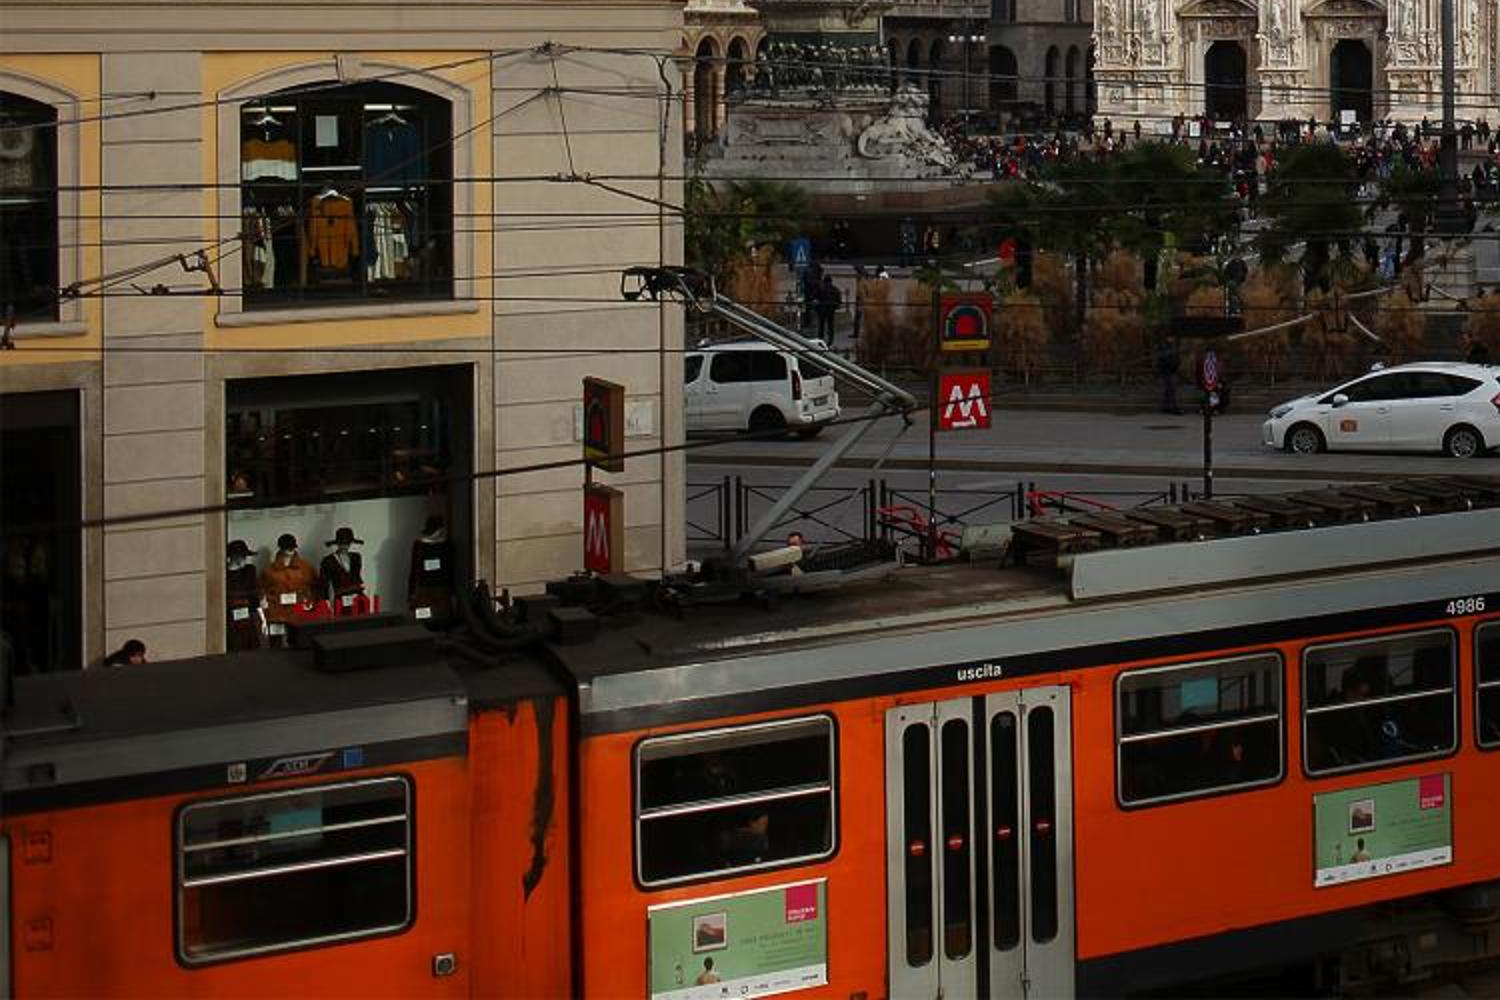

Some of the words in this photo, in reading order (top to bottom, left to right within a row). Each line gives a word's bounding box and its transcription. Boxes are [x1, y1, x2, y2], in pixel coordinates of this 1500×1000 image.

[943, 383, 987, 418] M
[586, 508, 609, 560] M
[1445, 596, 1485, 615] 4986
[957, 663, 1002, 681] uscita
